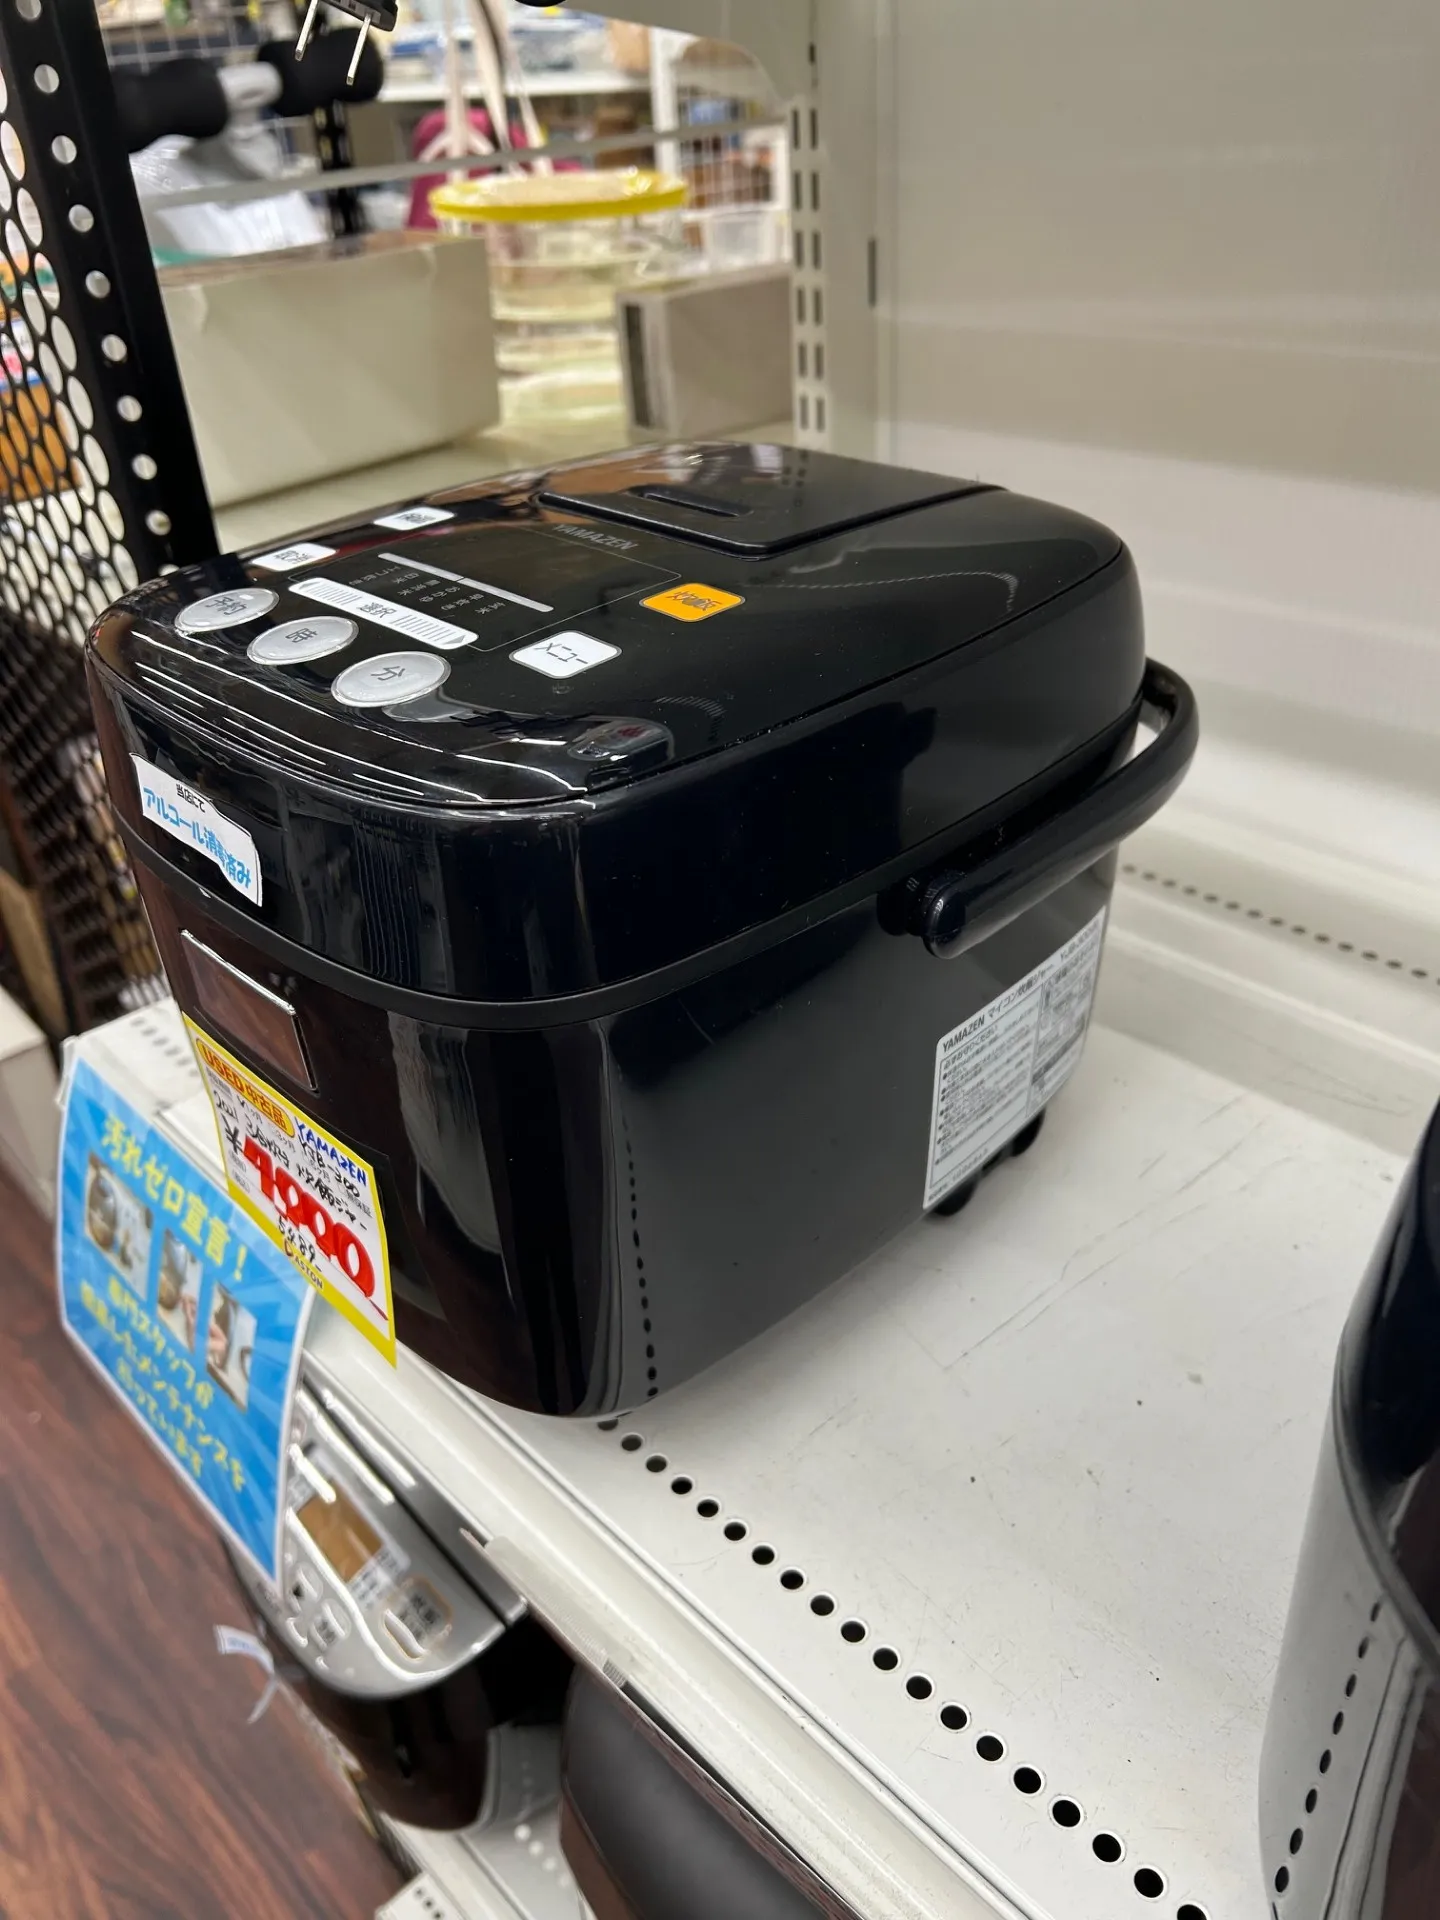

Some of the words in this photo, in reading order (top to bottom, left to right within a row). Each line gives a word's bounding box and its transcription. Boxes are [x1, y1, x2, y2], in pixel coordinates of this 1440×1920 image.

[553, 523, 637, 550] YAMAZEN
[206, 596, 249, 616] 予約
[357, 601, 398, 619] 選択
[666, 590, 716, 612] 炊飯
[285, 628, 318, 644] 時
[533, 641, 590, 671] メニュー
[371, 666, 403, 681] 分
[176, 783, 206, 813] 当店にて
[143, 788, 252, 889] アルコール消毒済み
[941, 1014, 985, 1053] YAMAZEN
[203, 1045, 245, 1092] USED
[246, 1085, 288, 1131] 中古品
[295, 1117, 367, 1186] YAMAZEN
